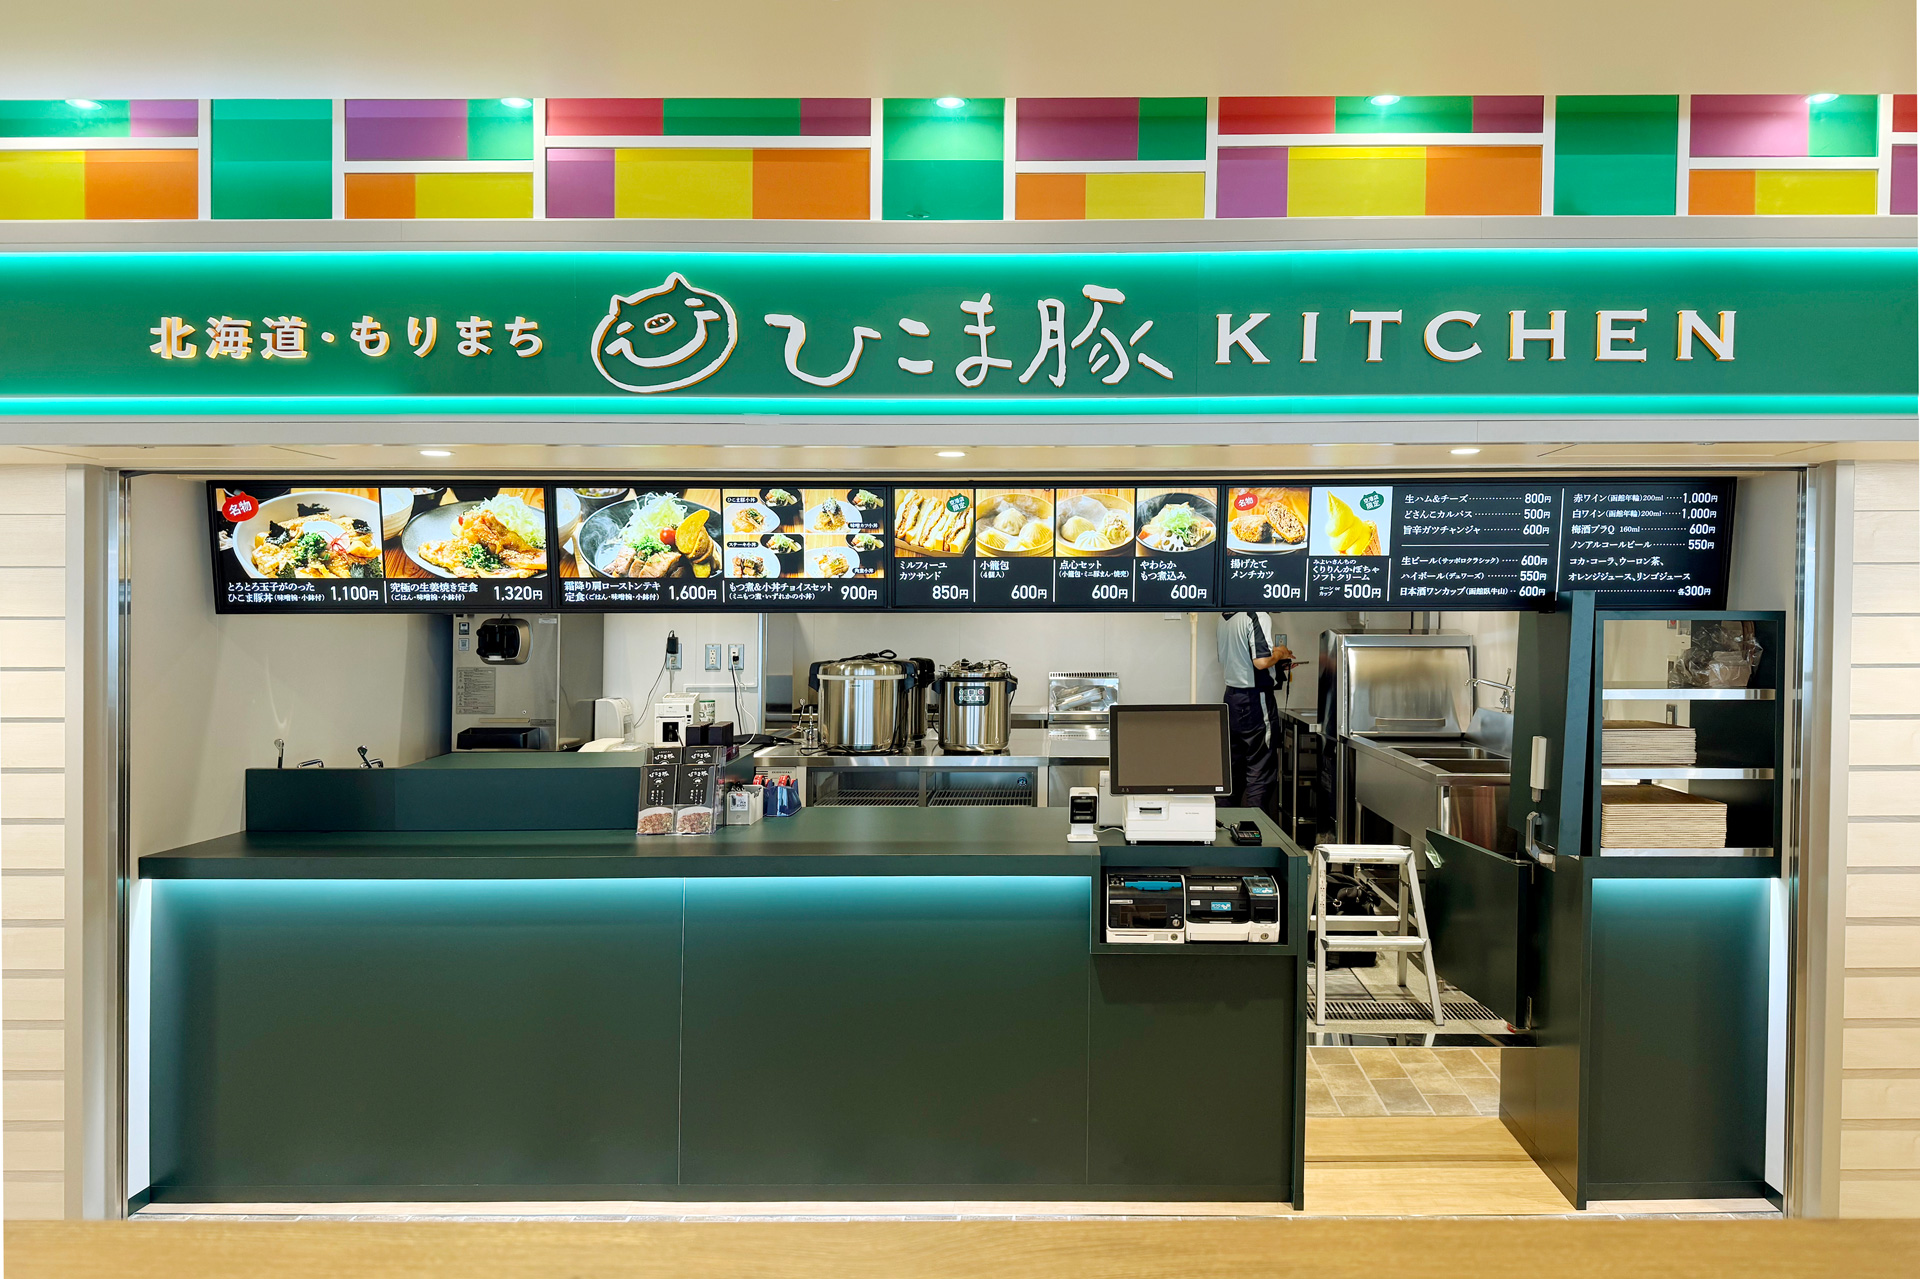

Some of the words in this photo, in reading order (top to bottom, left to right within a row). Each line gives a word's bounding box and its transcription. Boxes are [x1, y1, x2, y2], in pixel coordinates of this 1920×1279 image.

[149, 314, 544, 360] 北海道・もりまち
[764, 284, 1174, 387] ひこま豚
[1214, 308, 1738, 364] KITCHEN
[1237, 497, 1253, 507] 名物
[1405, 494, 1468, 503] 生ハム&チーズ
[1524, 493, 1551, 504] 800円
[1683, 492, 1718, 504] 1,000円
[229, 500, 253, 516] 名物
[1681, 508, 1717, 519] 1,000円
[1404, 510, 1472, 519] どさんこカルパス
[1524, 509, 1551, 519] 500円
[1522, 524, 1550, 535] 600円
[1689, 524, 1716, 535] 600円
[1570, 540, 1652, 549] ノンアルコールビール
[1688, 539, 1715, 550] 550円
[899, 561, 948, 570] ミルフィーユ
[1059, 560, 1102, 570] 点心セット
[1140, 560, 1177, 570] やわらか
[1230, 559, 1268, 569] 揚げたて
[1520, 555, 1547, 566] 600円
[1230, 570, 1274, 580] メンチカツ
[1313, 565, 1380, 574] くりりんかぼちゃ
[899, 571, 942, 581] カツサンド
[1140, 571, 1187, 581] もつ煮込み
[1520, 570, 1547, 581] 550円
[228, 582, 315, 592] とろとろ玉子がのった
[390, 582, 478, 593] 究極の生姜焼き定食
[564, 581, 661, 591] 霜降り肩ローストンテキ
[1091, 584, 1128, 599] 600円
[1170, 584, 1207, 599] 600円
[1263, 583, 1300, 599] 300円
[1344, 584, 1381, 599] 500円
[1518, 586, 1546, 597] 600円
[331, 586, 379, 601] 1,100円
[494, 586, 543, 601] 1,320円
[669, 585, 717, 600] 1,600円
[840, 585, 878, 600] 900円
[932, 585, 969, 600] 850円
[1011, 584, 1048, 600] 600円
